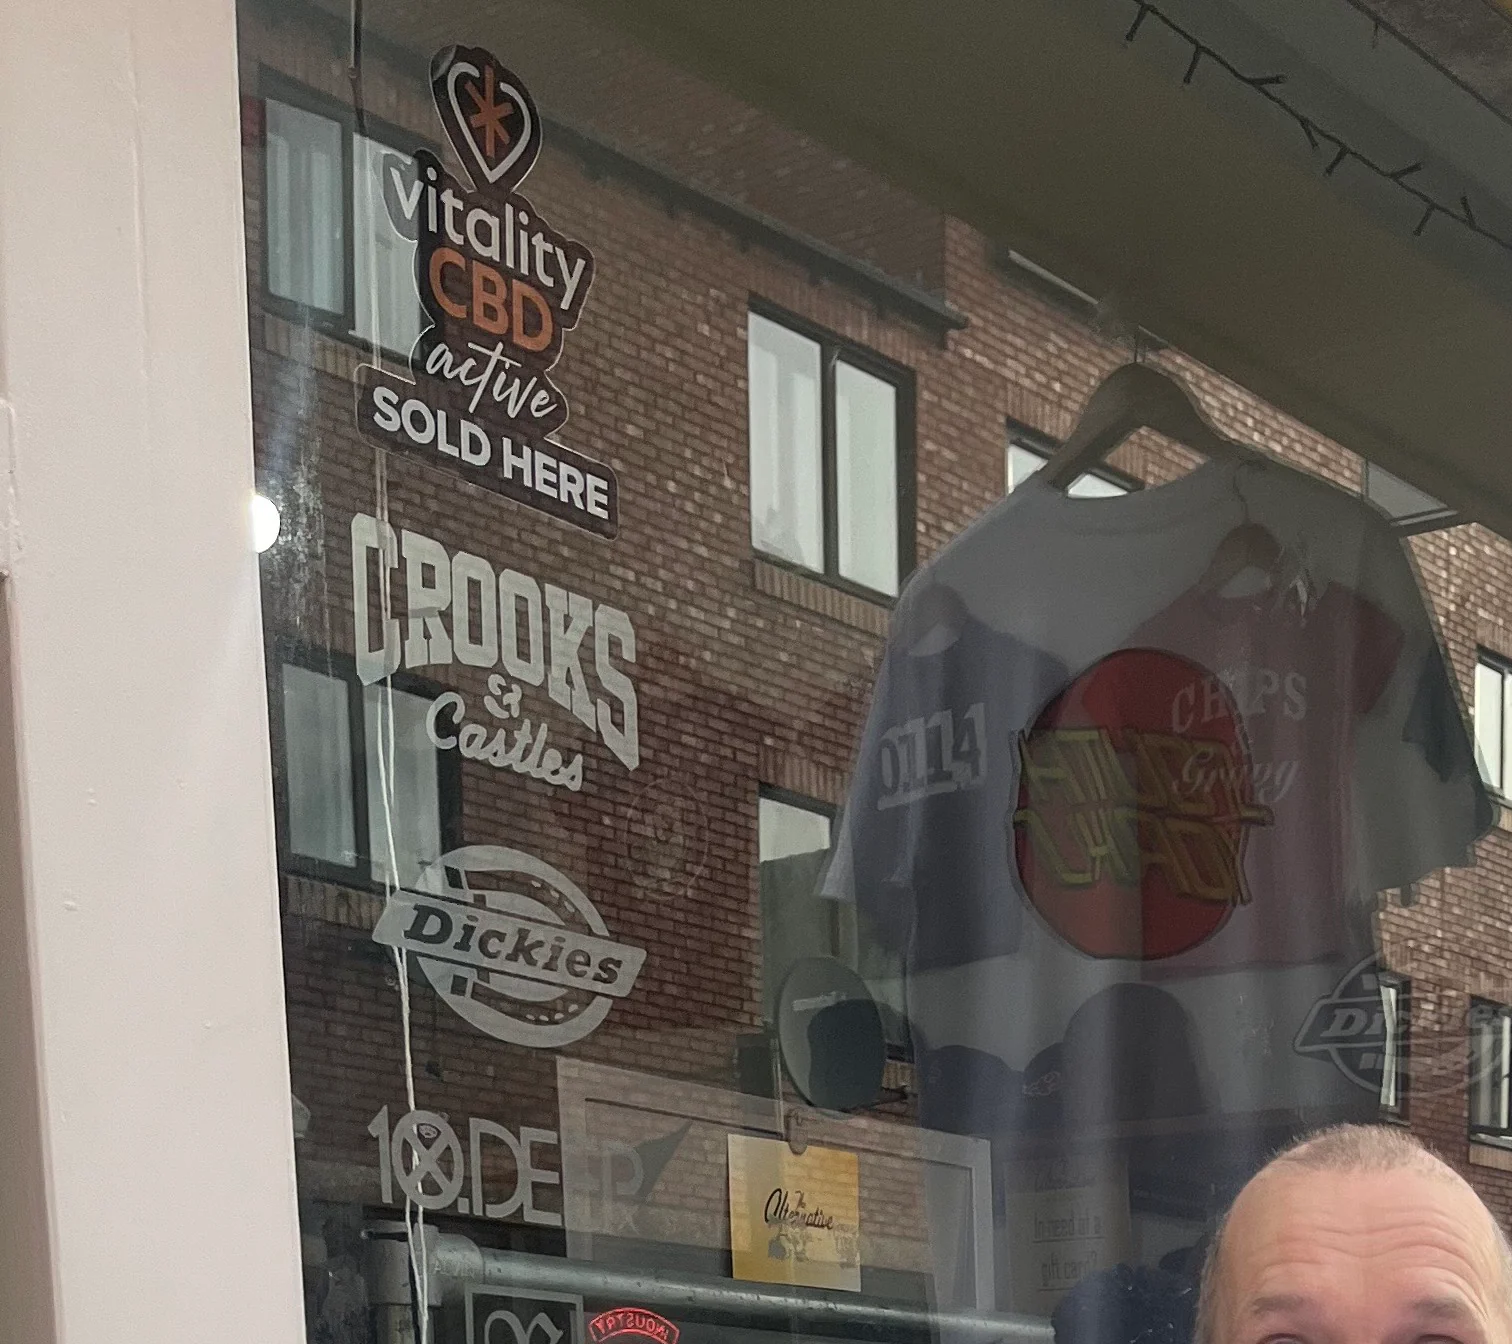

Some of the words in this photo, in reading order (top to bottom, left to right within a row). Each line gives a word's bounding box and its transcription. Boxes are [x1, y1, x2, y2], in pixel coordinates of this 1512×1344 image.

[428, 247, 554, 352] CBD
[426, 341, 558, 419] active
[372, 385, 491, 468] SOLD
[502, 436, 610, 520] HERE
[350, 512, 640, 772] CROOKS
[425, 691, 585, 792] Castles
[1171, 668, 1308, 734] CHPS
[403, 903, 624, 985] Dickies
[367, 1103, 645, 1232] 10.DEP
